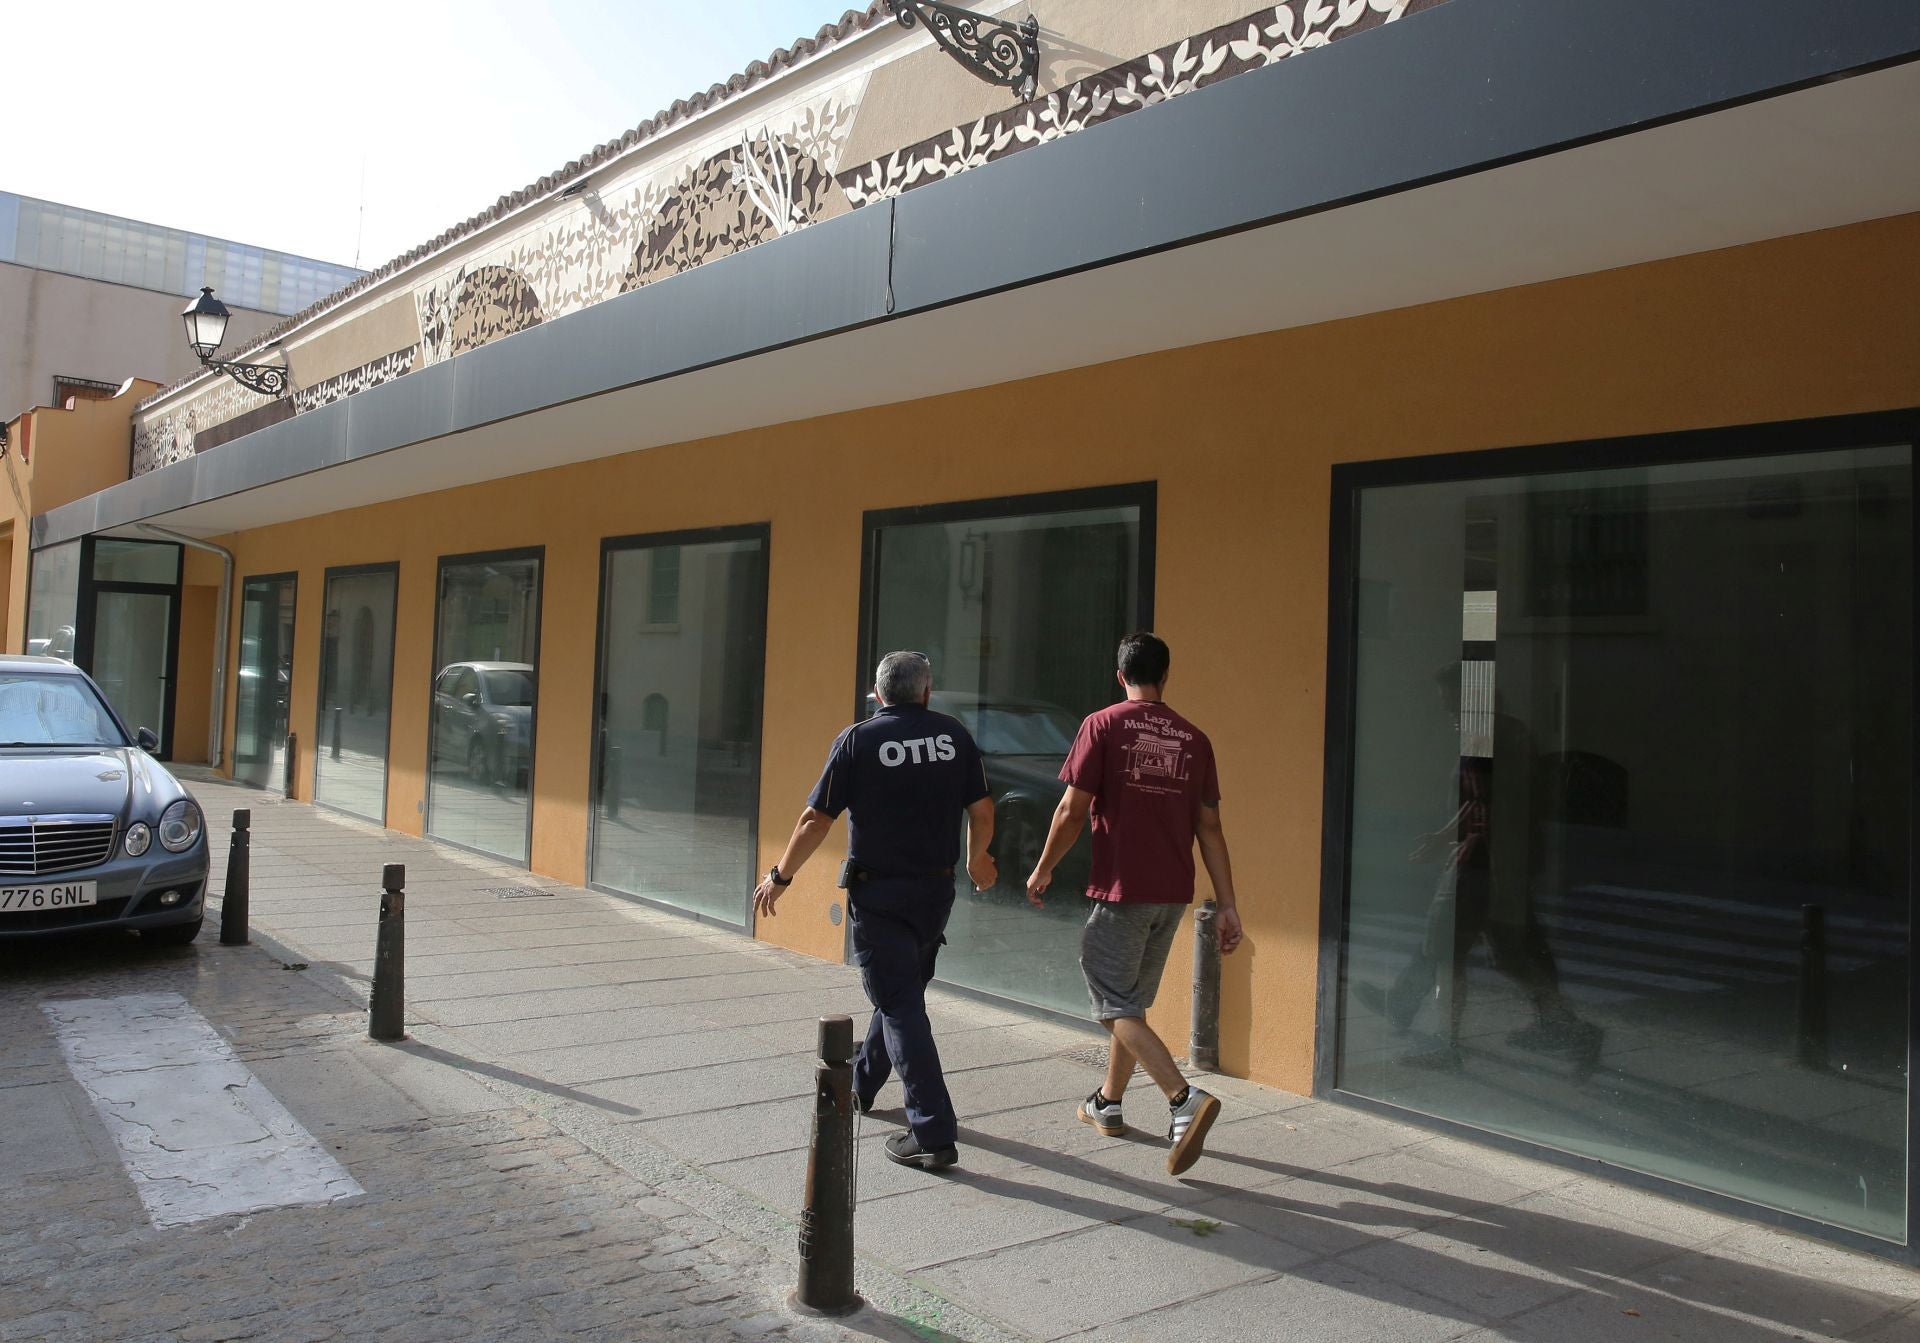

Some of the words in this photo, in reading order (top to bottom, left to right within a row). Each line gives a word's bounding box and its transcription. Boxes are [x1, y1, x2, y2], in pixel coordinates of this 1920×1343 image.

[1124, 719, 1160, 733] Music
[1161, 726, 1193, 741] Shop
[1144, 712, 1172, 727] Lazy
[878, 734, 956, 767] OTIS
[2, 889, 44, 908] 776
[51, 885, 89, 906] GNL
